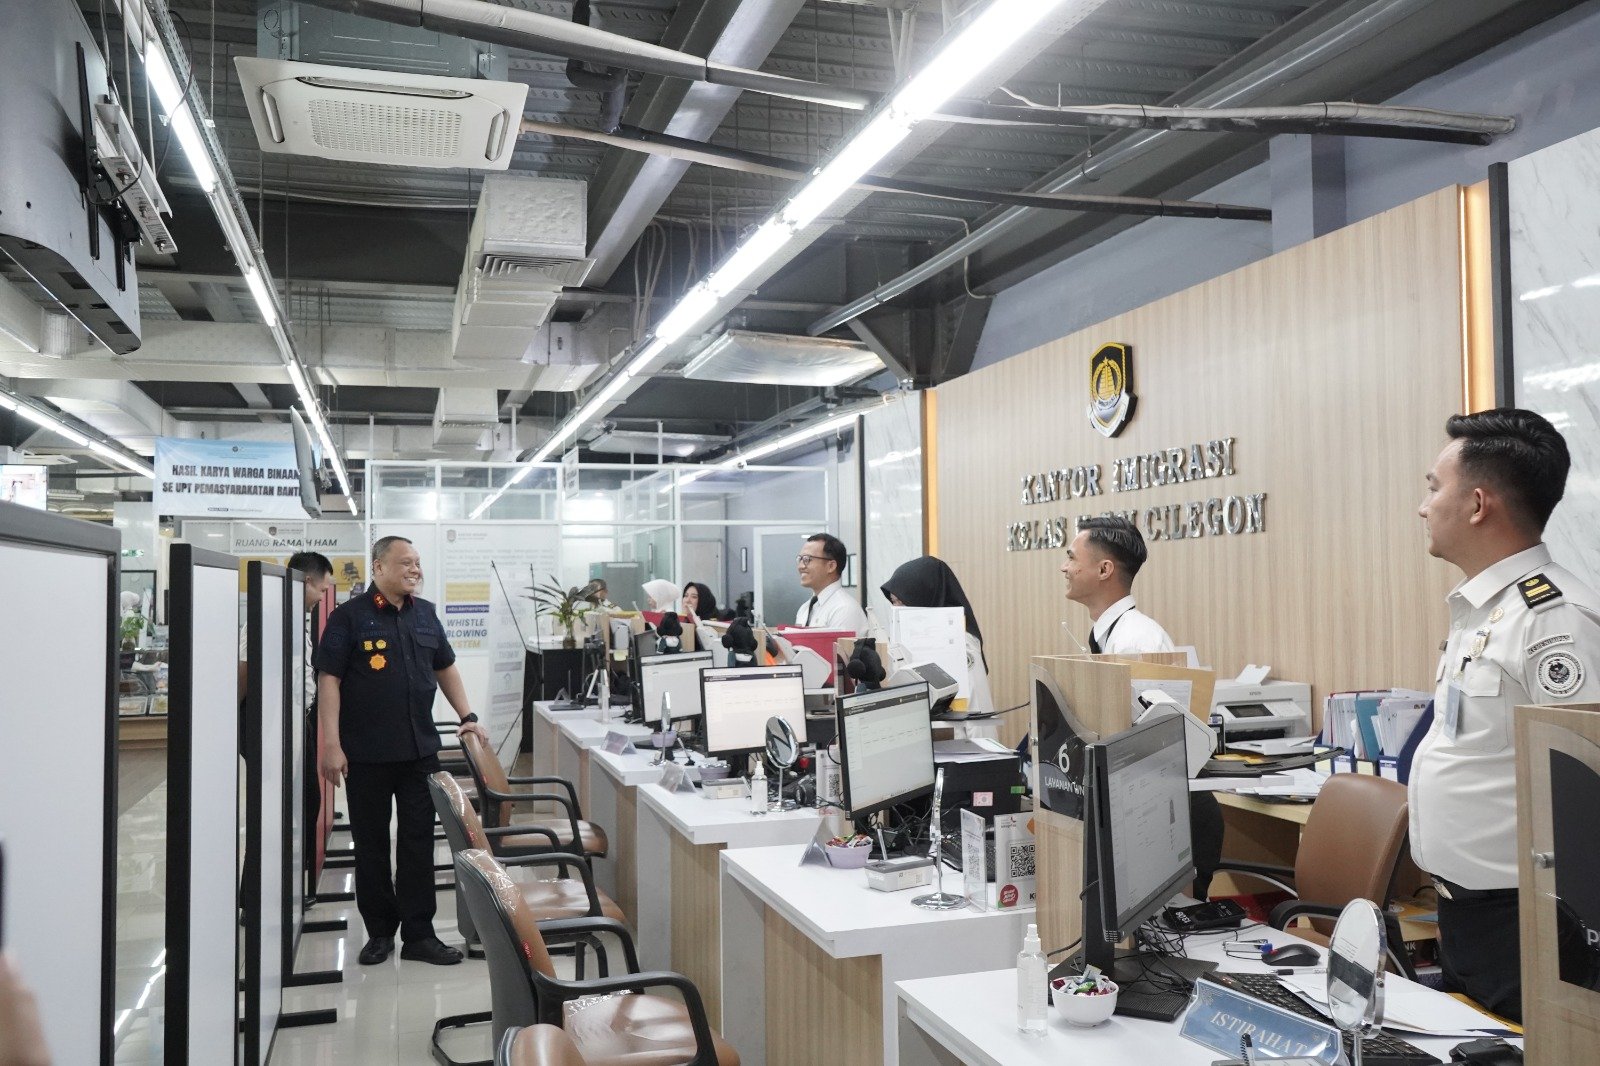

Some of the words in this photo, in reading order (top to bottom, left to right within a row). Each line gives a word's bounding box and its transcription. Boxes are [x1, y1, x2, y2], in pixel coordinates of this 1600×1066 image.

[172, 464, 198, 477] HASIL
[201, 465, 230, 478] KARYA
[233, 466, 264, 479] WARGA
[267, 468, 300, 480] BINAAN
[1021, 464, 1103, 505] KANTOR
[1112, 437, 1236, 493] IMIGRASI
[162, 482, 174, 493] SE
[176, 482, 192, 493] UPT
[194, 483, 274, 497] PEMASYARAKATAN
[1006, 516, 1068, 552] KELAS
[1145, 492, 1268, 542] CILEGON
[235, 538, 270, 547] RUANG
[313, 538, 338, 547] HAM
[447, 618, 484, 627] WHISTLE
[446, 629, 488, 638] BLOWING
[452, 639, 481, 648] YSTEM
[1058, 743, 1070, 774] 6
[1044, 776, 1073, 793] LAYANAN
[1210, 1011, 1308, 1057] ISTIRAHAT
